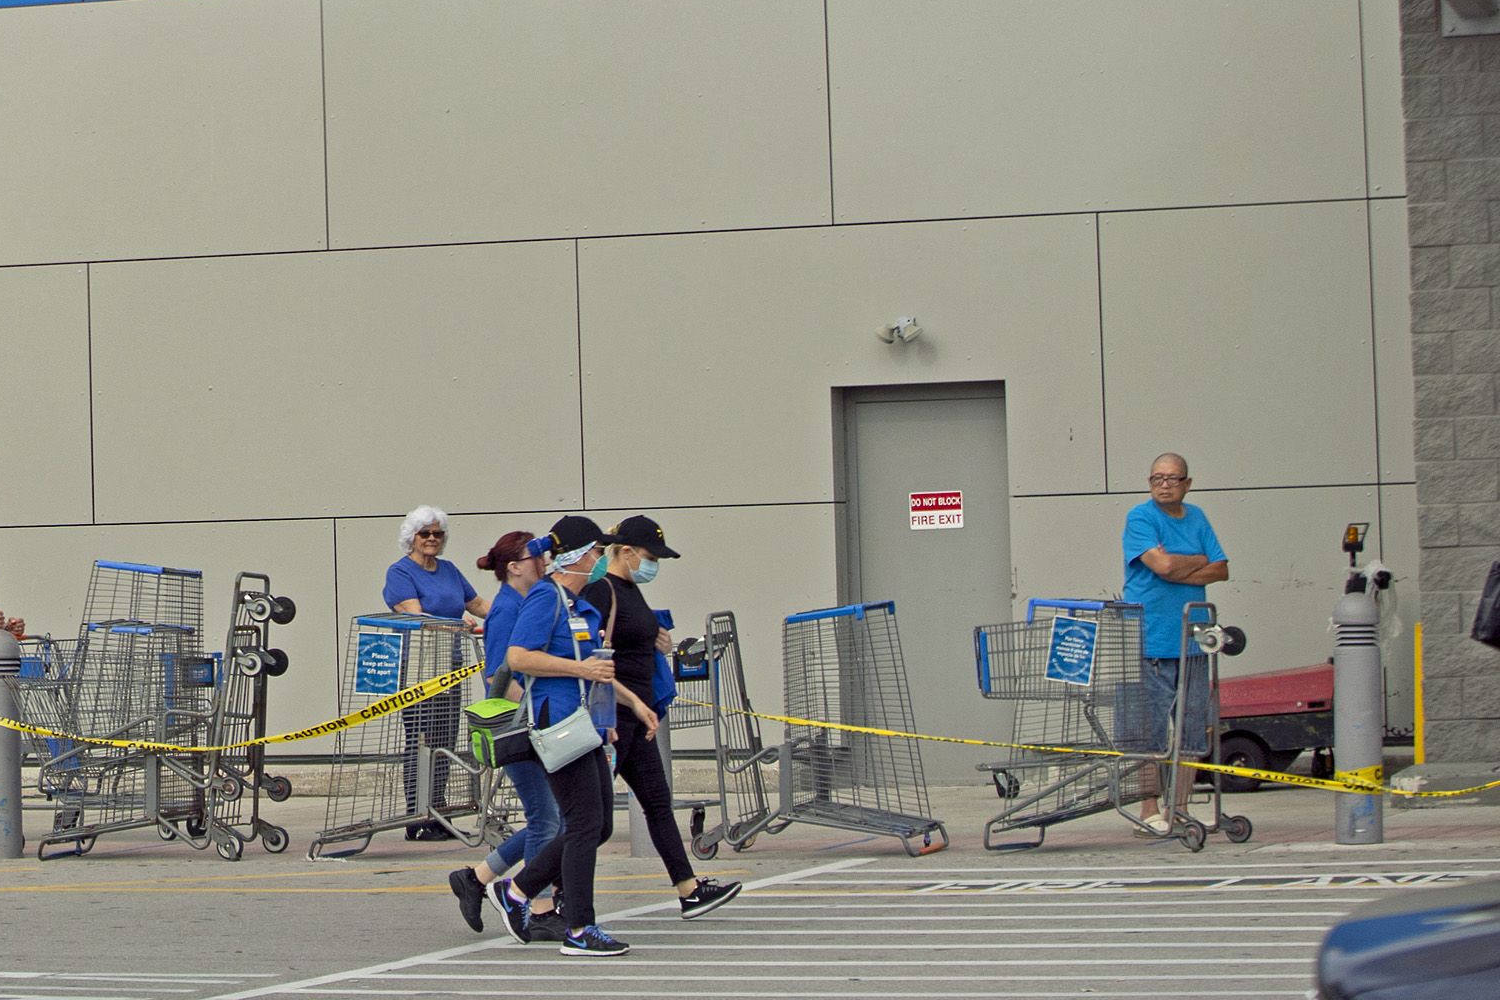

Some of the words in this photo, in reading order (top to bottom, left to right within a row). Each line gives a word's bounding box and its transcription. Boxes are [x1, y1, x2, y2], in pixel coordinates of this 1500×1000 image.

[911, 498, 921, 507] DO
[922, 497, 937, 507] NOT
[938, 496, 961, 506] BLOCK
[911, 515, 935, 526] FIRE
[938, 514, 961, 525] EXIT
[371, 652, 389, 660] Please
[362, 660, 377, 668] keep
[360, 685, 425, 720] CAUTION
[283, 718, 349, 742] CAUTION
